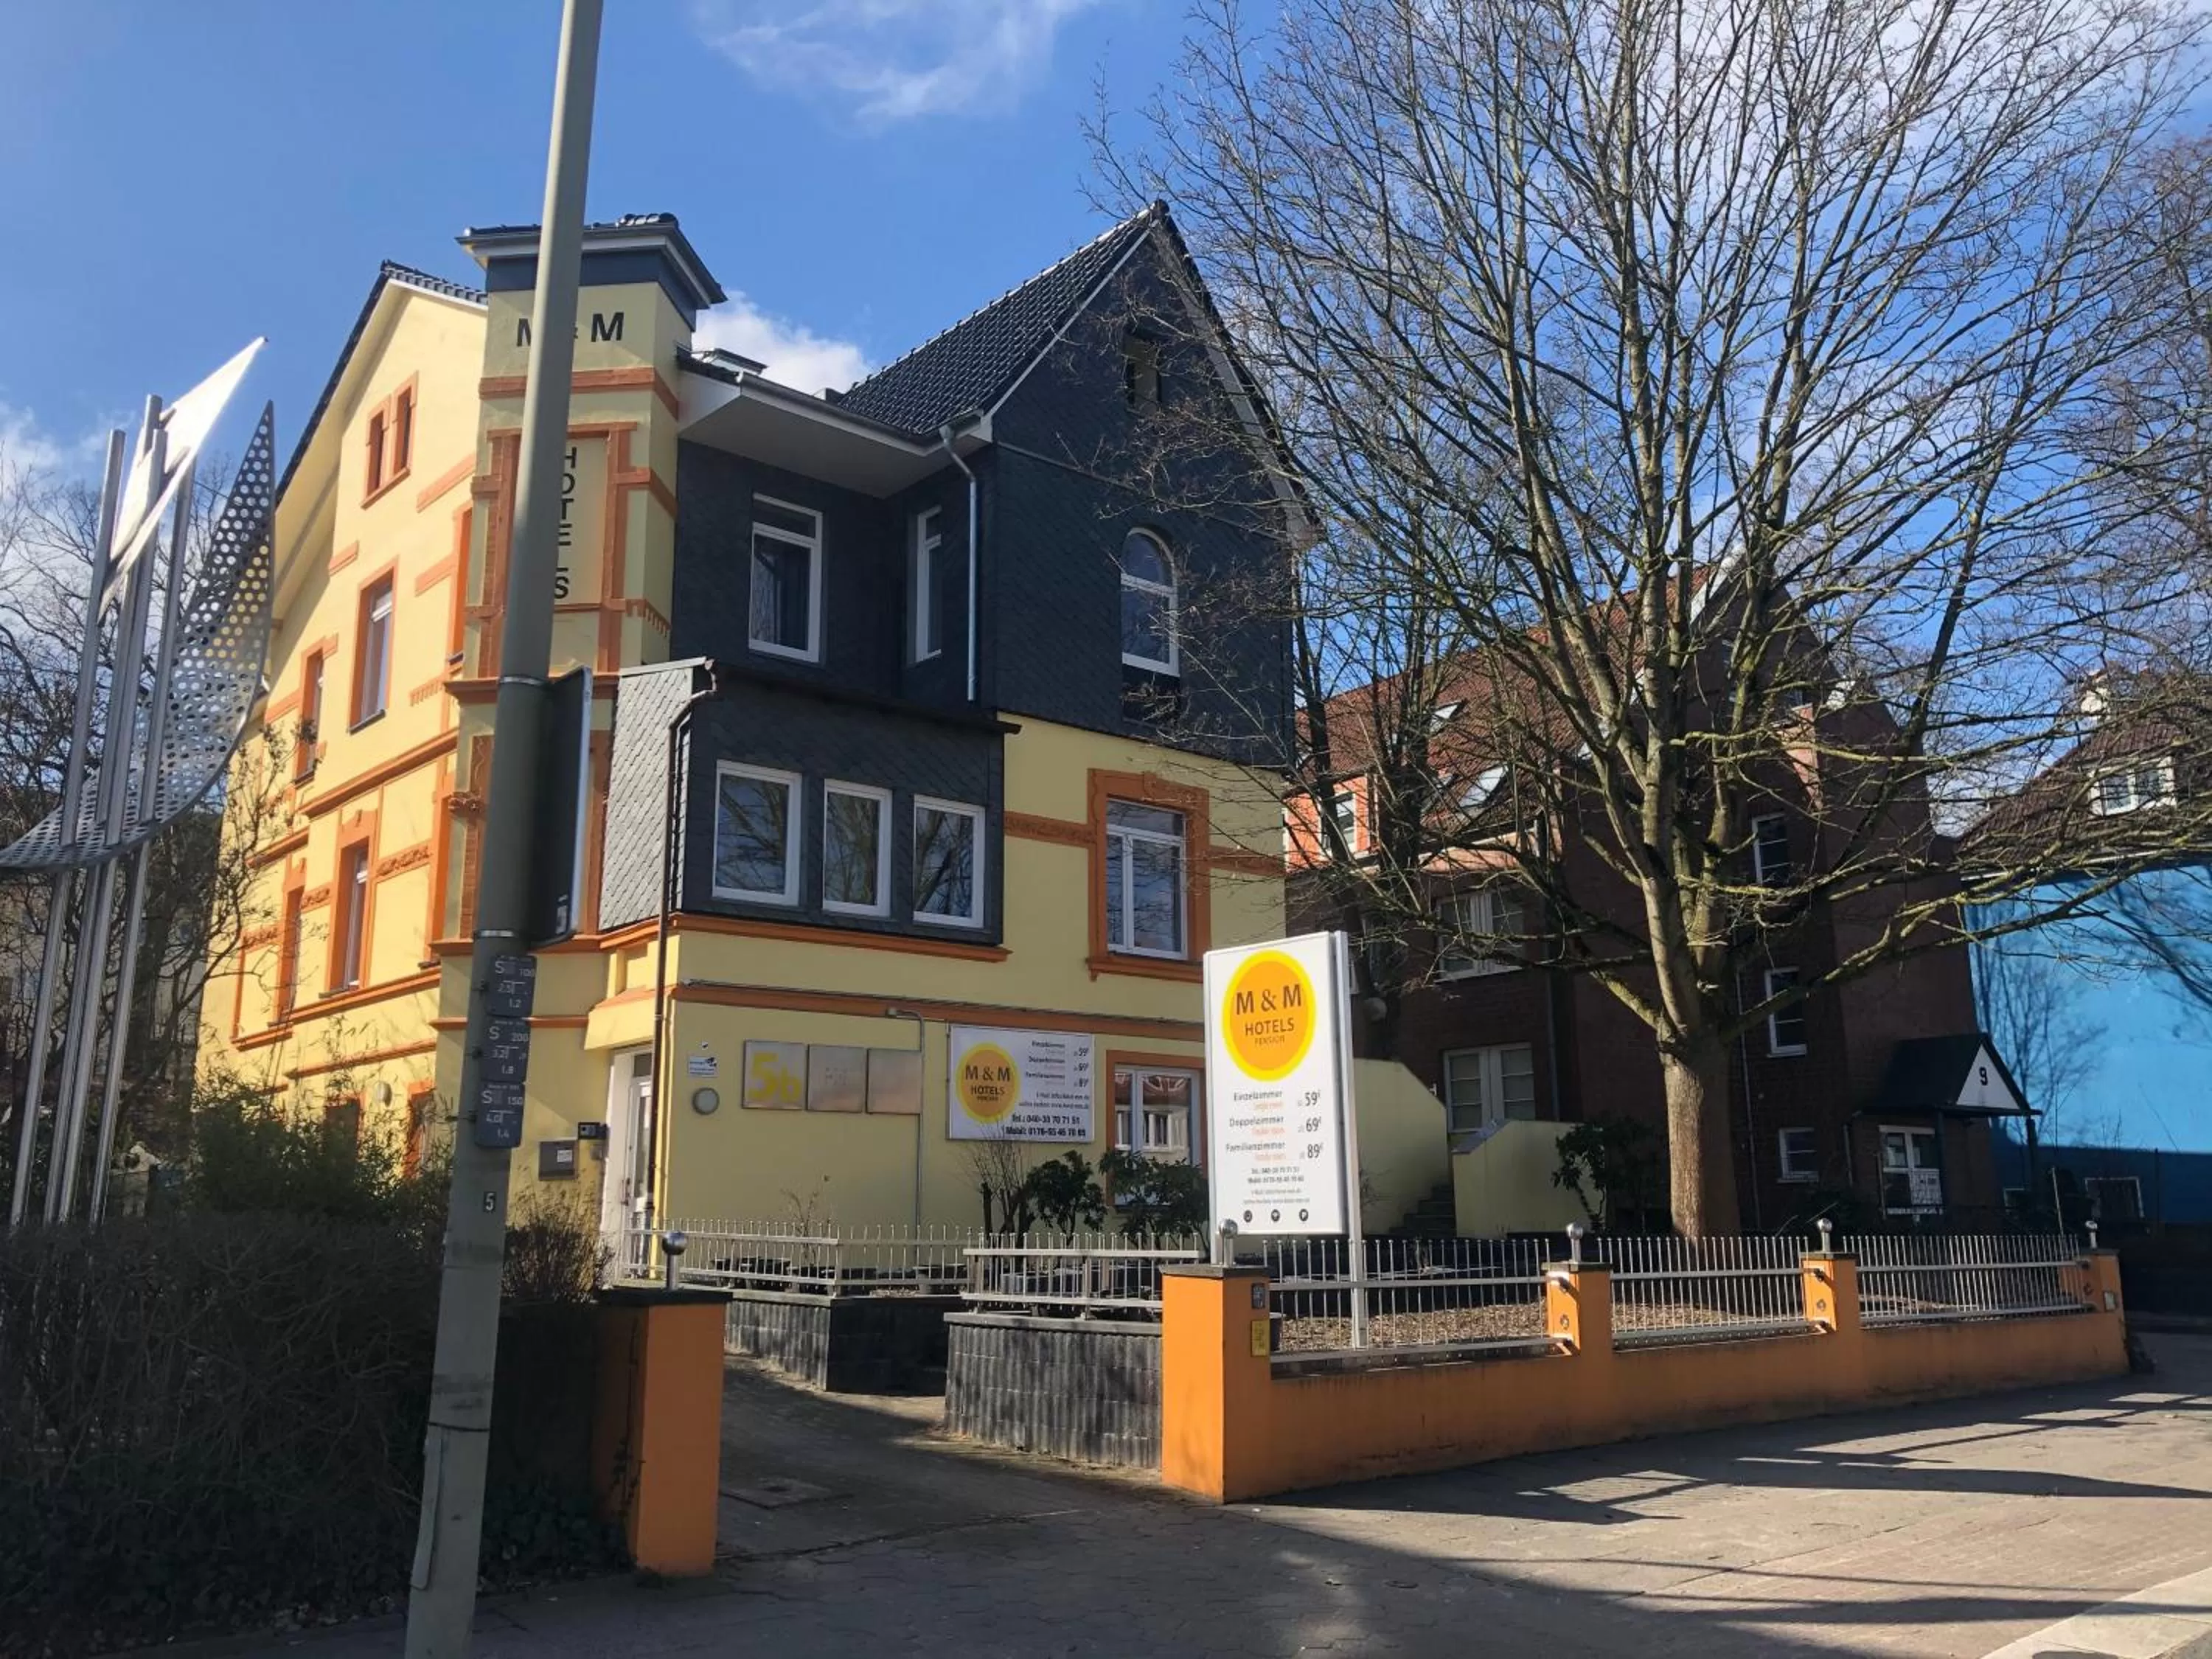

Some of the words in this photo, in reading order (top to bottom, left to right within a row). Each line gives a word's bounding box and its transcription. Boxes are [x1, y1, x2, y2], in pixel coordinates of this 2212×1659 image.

[591, 312, 625, 342] M
[554, 447, 577, 599] HOTES
[1237, 990, 1255, 1015] M
[1261, 989, 1276, 1012] &
[1283, 983, 1301, 1009] M
[489, 1026, 500, 1040] S
[1245, 1018, 1295, 1037] HOTELS
[965, 1065, 978, 1080] M
[983, 1066, 994, 1081] &
[998, 1066, 1011, 1082] M
[1979, 1067, 1989, 1086] 9
[482, 1091, 493, 1104] S
[970, 1085, 1005, 1095] HOTELS
[486, 1192, 495, 1211] 5
